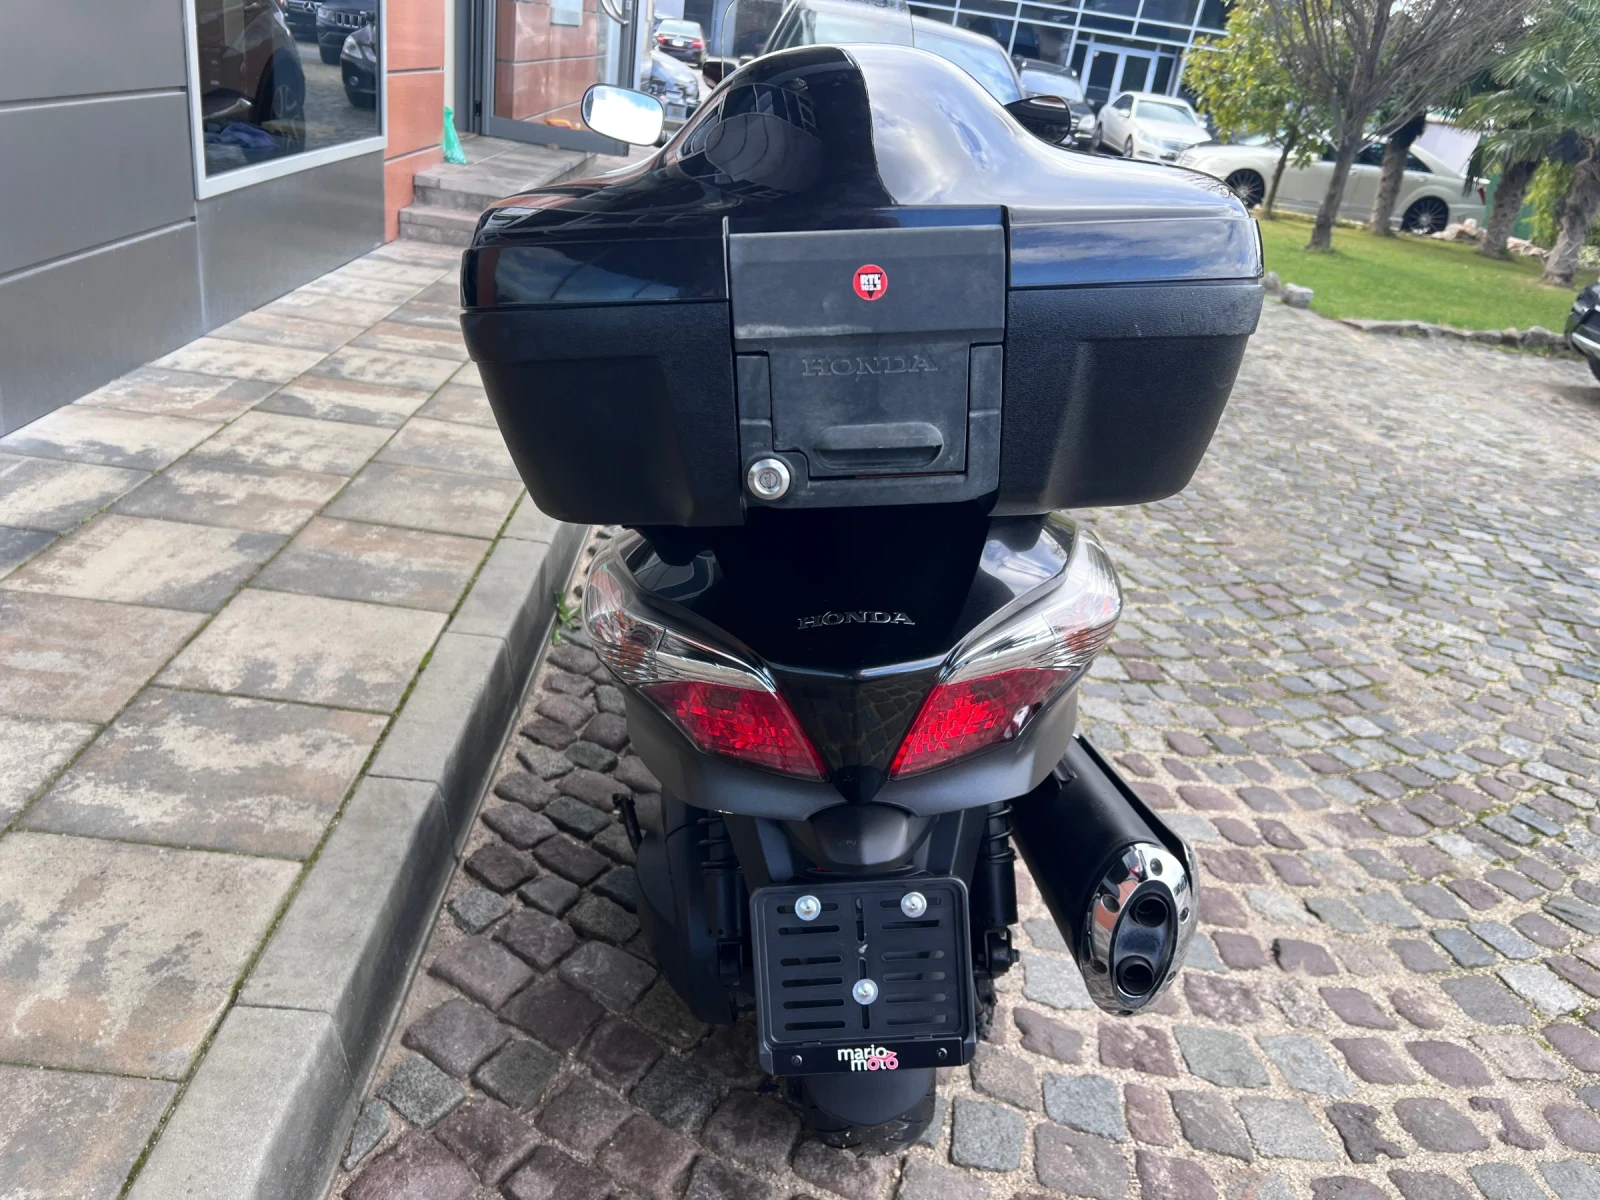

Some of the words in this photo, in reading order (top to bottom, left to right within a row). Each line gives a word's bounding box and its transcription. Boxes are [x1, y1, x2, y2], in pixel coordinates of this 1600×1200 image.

[802, 355, 938, 376] HONDA
[798, 611, 915, 629] HONDA
[837, 1044, 888, 1061] mario
